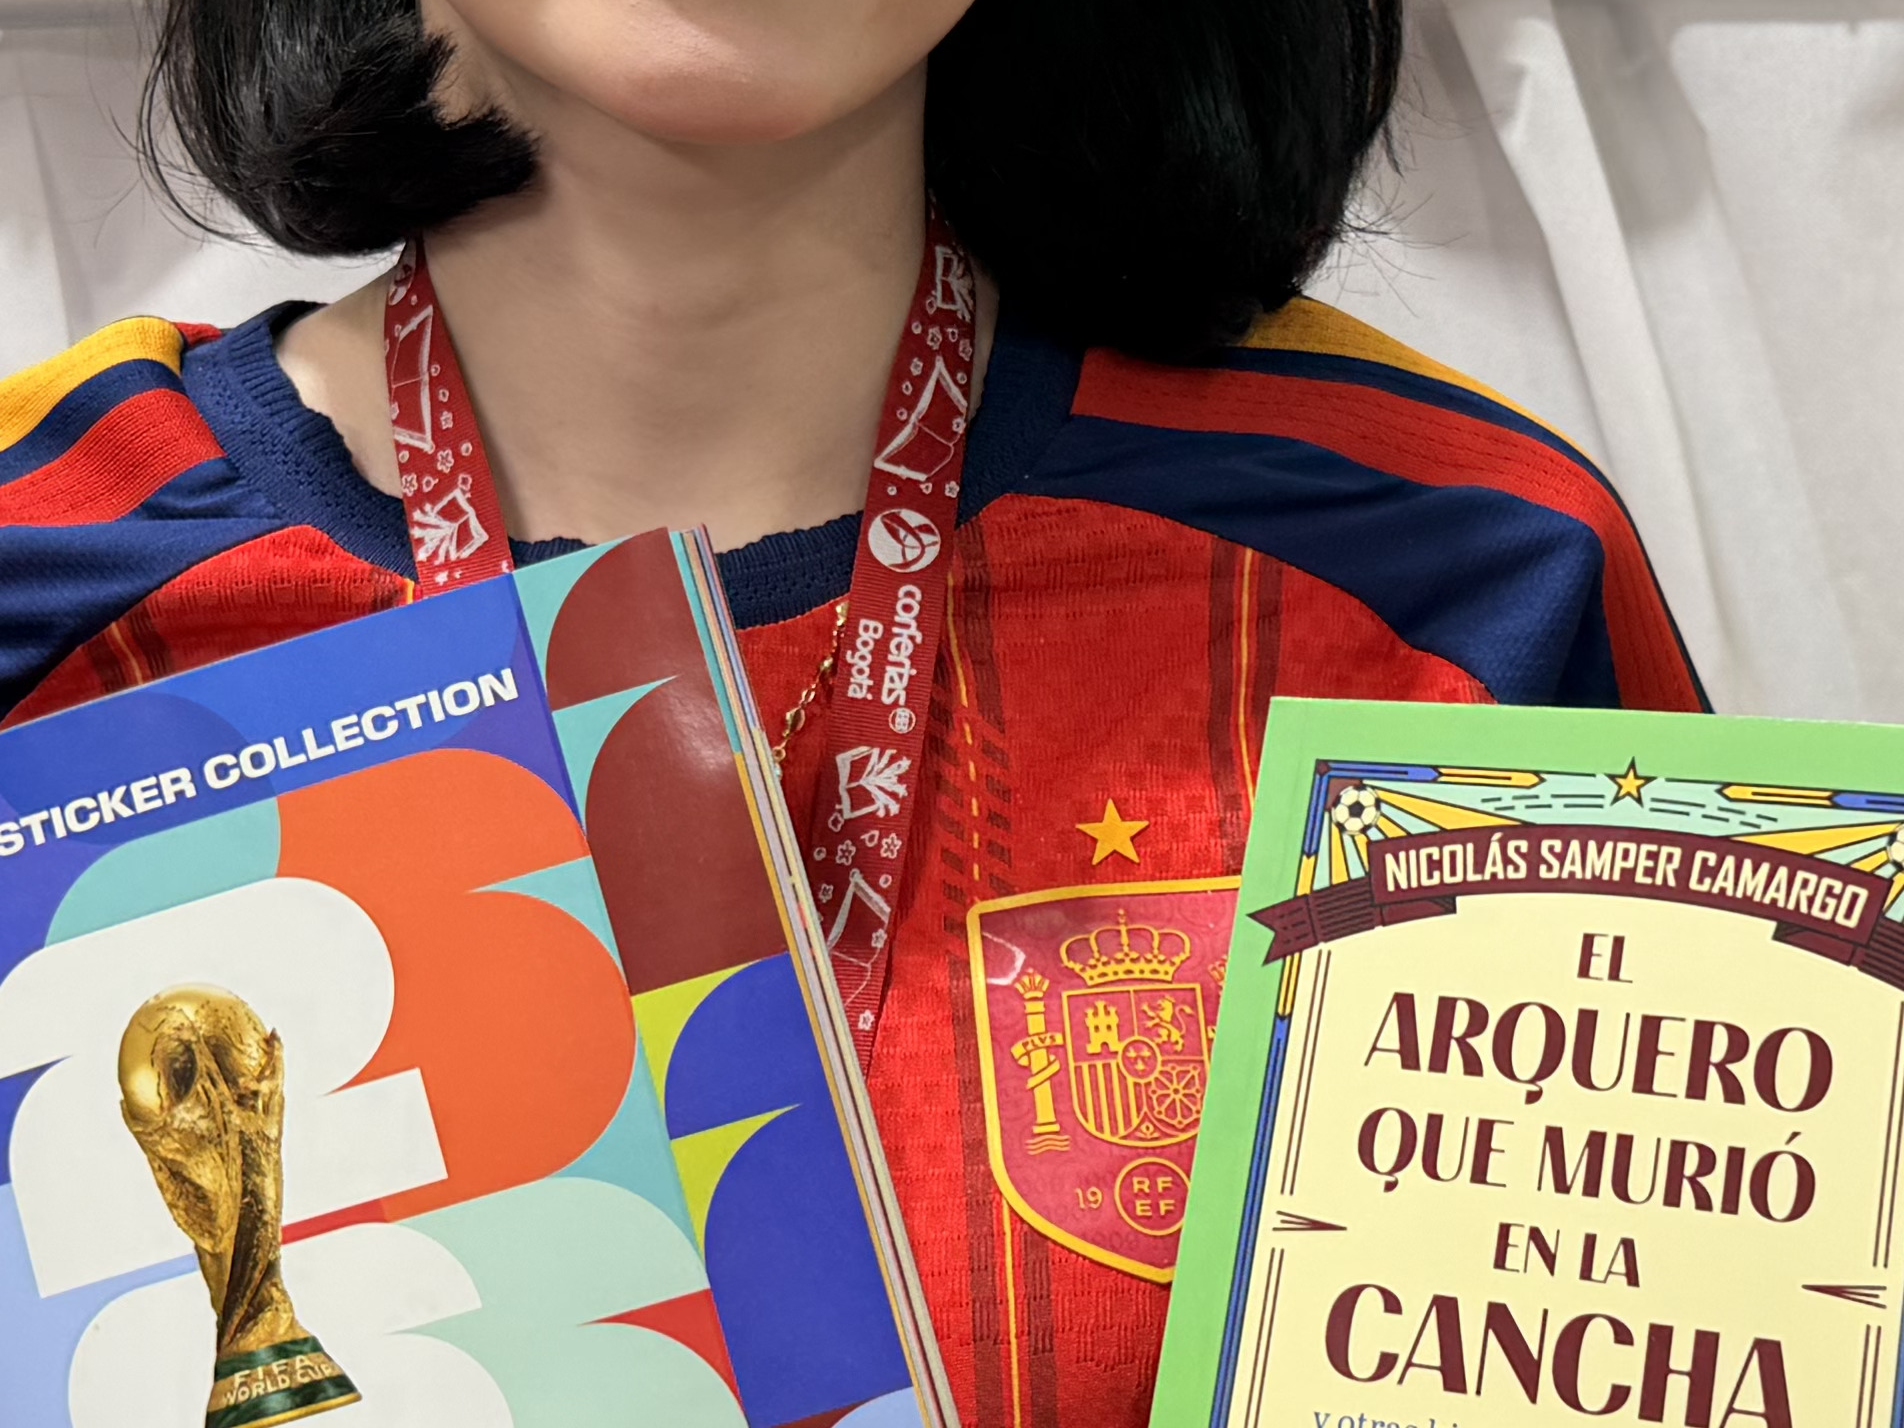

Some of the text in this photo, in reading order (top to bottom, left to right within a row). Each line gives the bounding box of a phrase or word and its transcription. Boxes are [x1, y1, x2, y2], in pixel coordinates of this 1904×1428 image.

[846, 618, 884, 701] Bogotá
[881, 584, 923, 706] corferias
[202, 667, 521, 790] COLLECTION
[1383, 831, 1870, 930] NICOLÁS SAMPER CAMARGO
[1576, 932, 1634, 984] EL
[1364, 991, 1834, 1113] ARQUERO
[1075, 1185, 1104, 1210] 19
[1357, 1107, 1817, 1224] QUE MURIÓ
[1492, 1222, 1641, 1288] EN LA
[222, 1362, 334, 1406] WORLD CUP
[232, 1354, 315, 1390] FIFA
